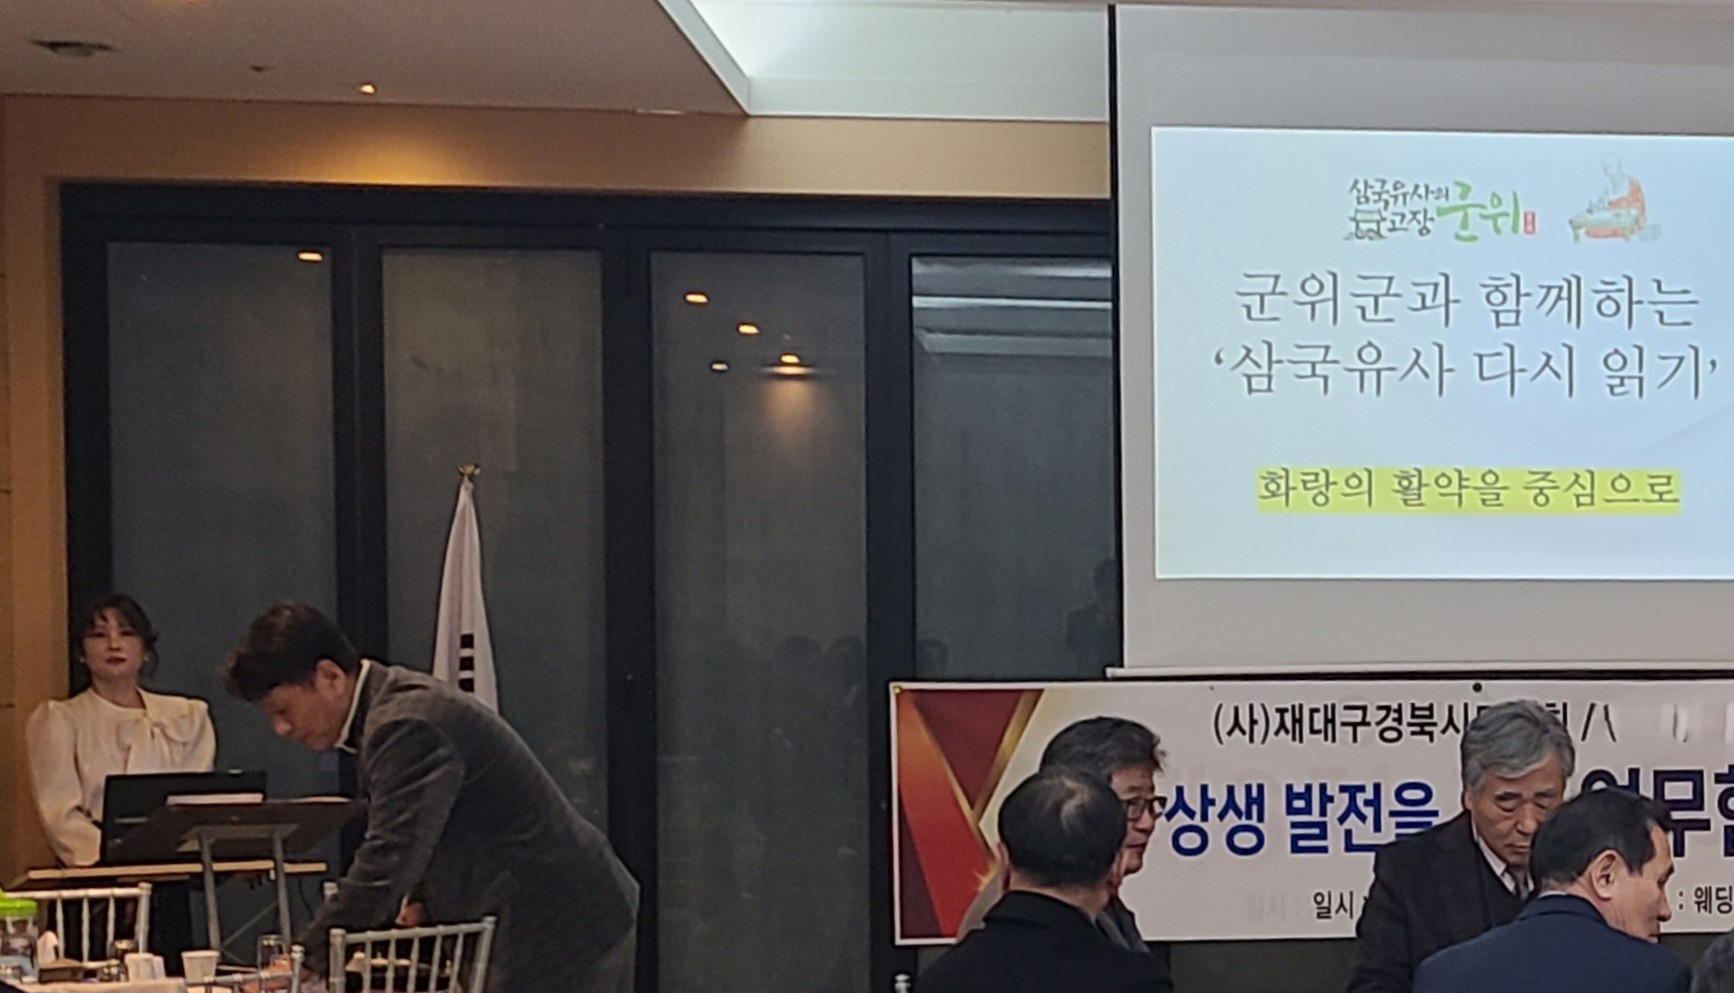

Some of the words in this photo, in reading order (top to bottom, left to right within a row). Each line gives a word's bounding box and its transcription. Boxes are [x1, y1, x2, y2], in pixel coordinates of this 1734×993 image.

[1349, 178, 1449, 210] 삼국유사의
[1436, 180, 1520, 242] 군위
[1387, 208, 1435, 236] 고장
[1235, 270, 1461, 328] 군위군과
[1479, 272, 1699, 330] 함께하는
[1473, 342, 1574, 399] 다시
[1258, 467, 1374, 508] 화랑의
[1391, 468, 1510, 508] 활약을
[1522, 468, 1680, 508] 중심으로
[1213, 702, 1568, 745] (사)재대구경북시
[1164, 782, 1266, 857] 상생
[1284, 781, 1440, 855] 발전을
[1313, 890, 1354, 919] 일시
